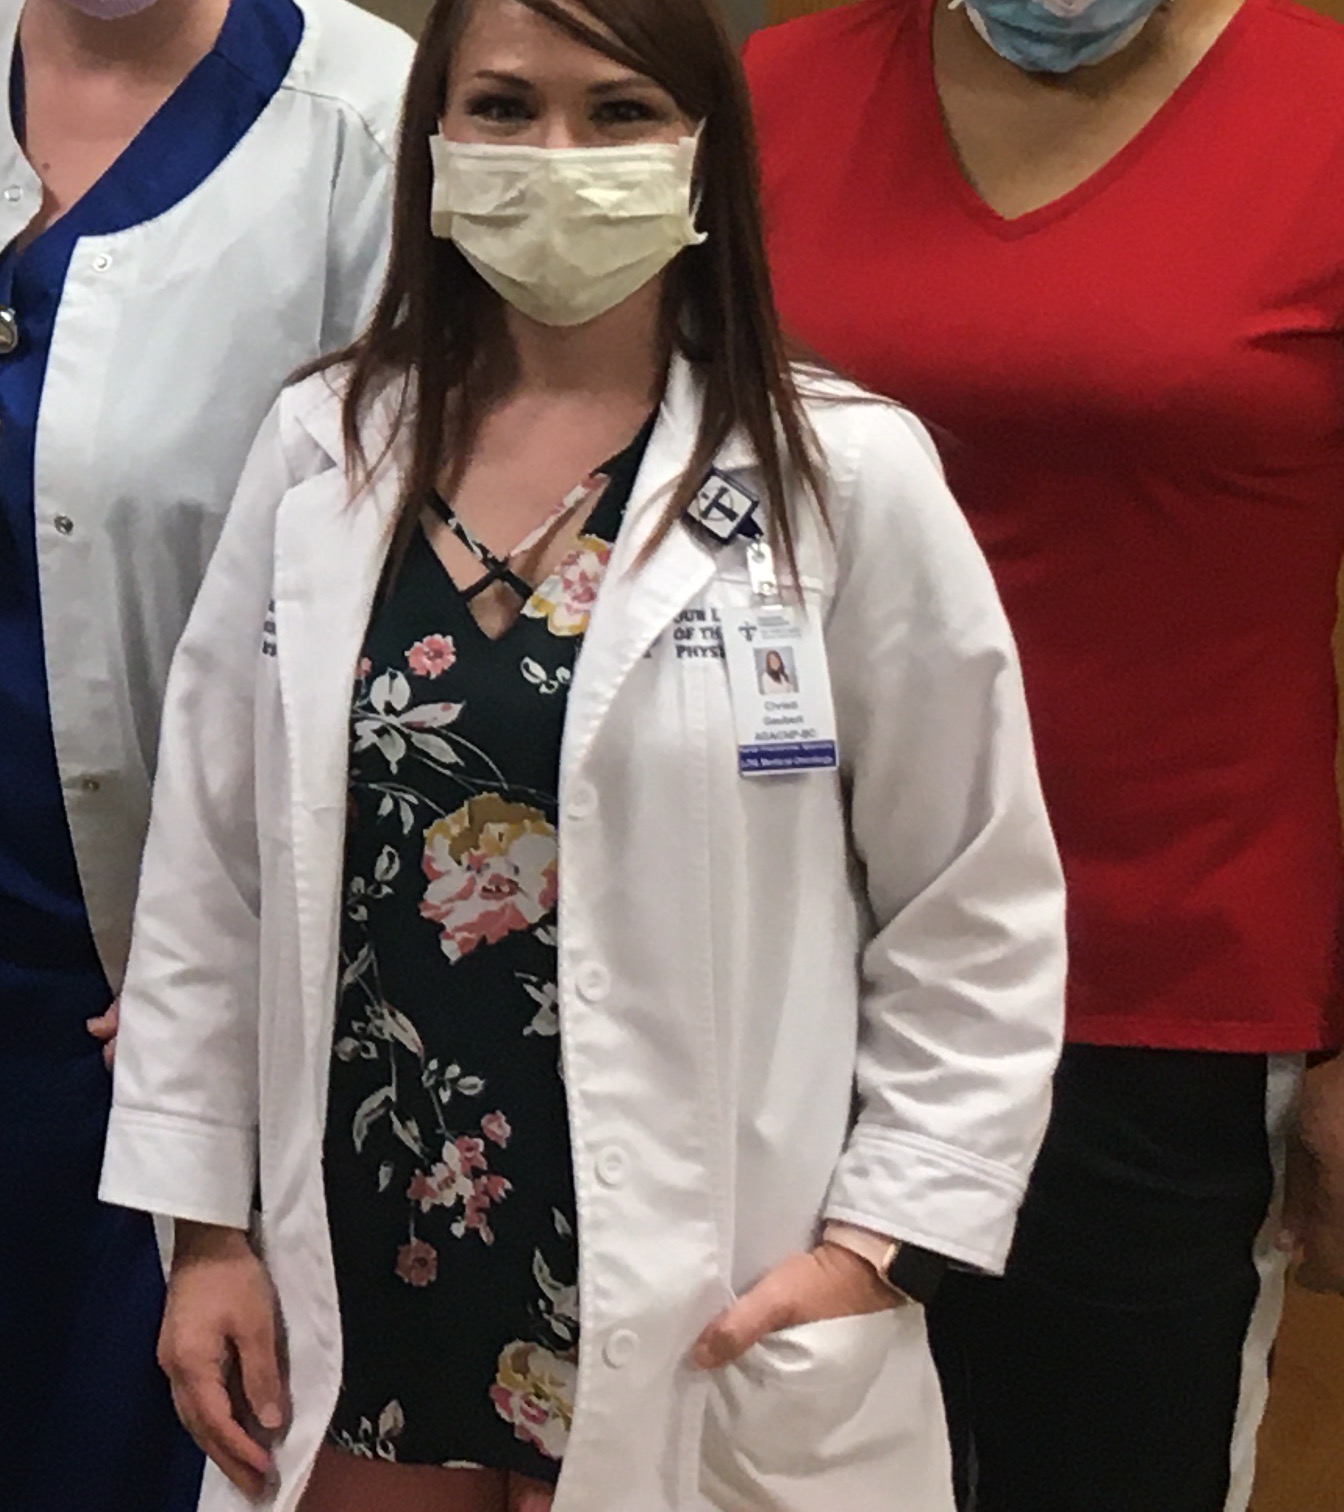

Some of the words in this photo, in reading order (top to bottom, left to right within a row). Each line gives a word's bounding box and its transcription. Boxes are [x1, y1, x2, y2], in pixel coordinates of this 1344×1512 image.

[711, 608, 721, 622] L
[673, 627, 695, 641] OF
[699, 626, 722, 640] TH
